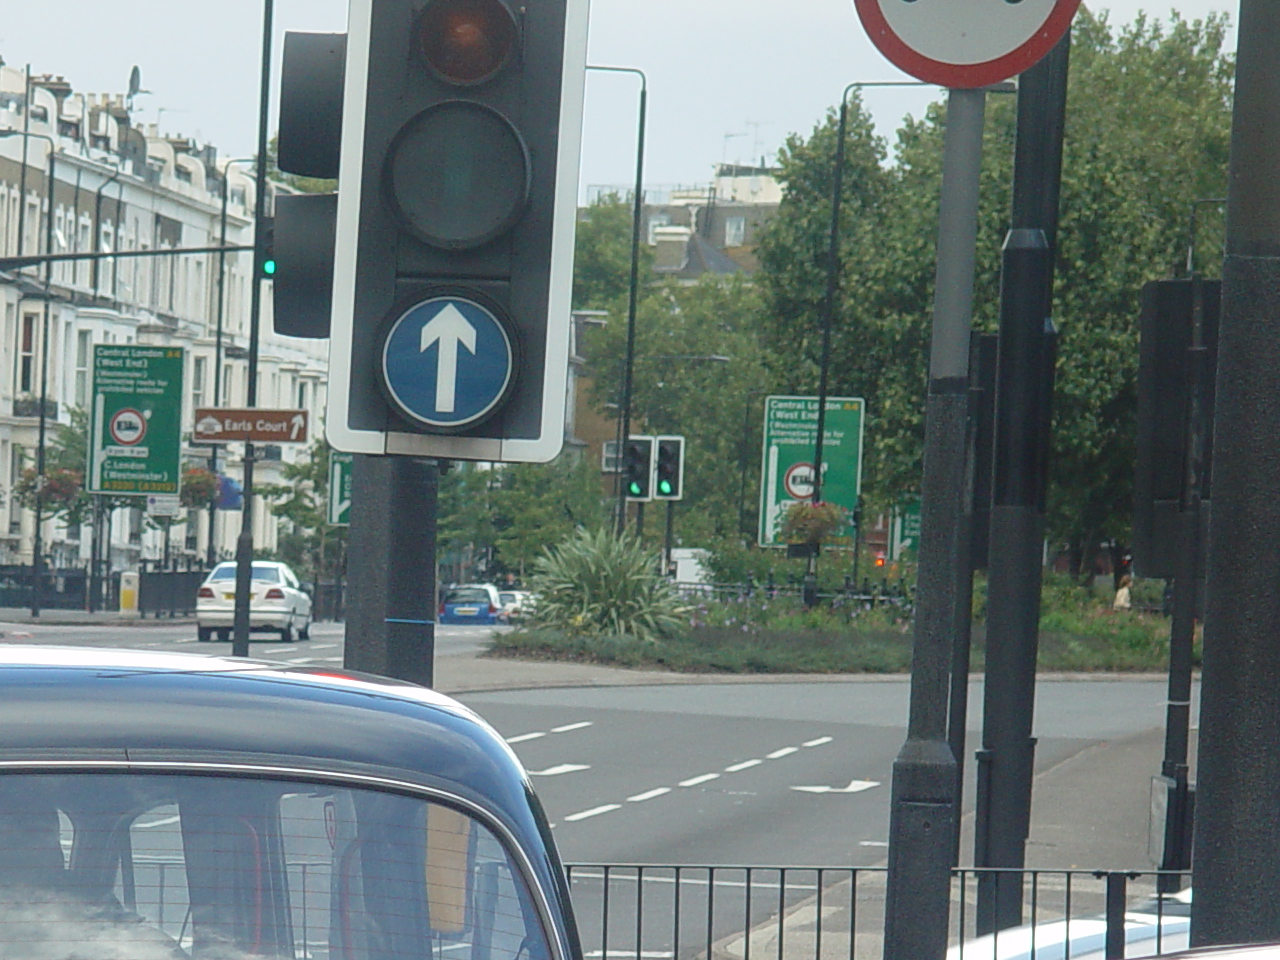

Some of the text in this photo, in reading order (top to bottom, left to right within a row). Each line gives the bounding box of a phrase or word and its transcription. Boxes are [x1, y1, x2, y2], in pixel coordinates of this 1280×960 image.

[96, 347, 130, 357] Central
[131, 348, 164, 358] London
[770, 400, 805, 410] Central
[770, 410, 799, 419] (West
[224, 419, 287, 432] Earls Court
